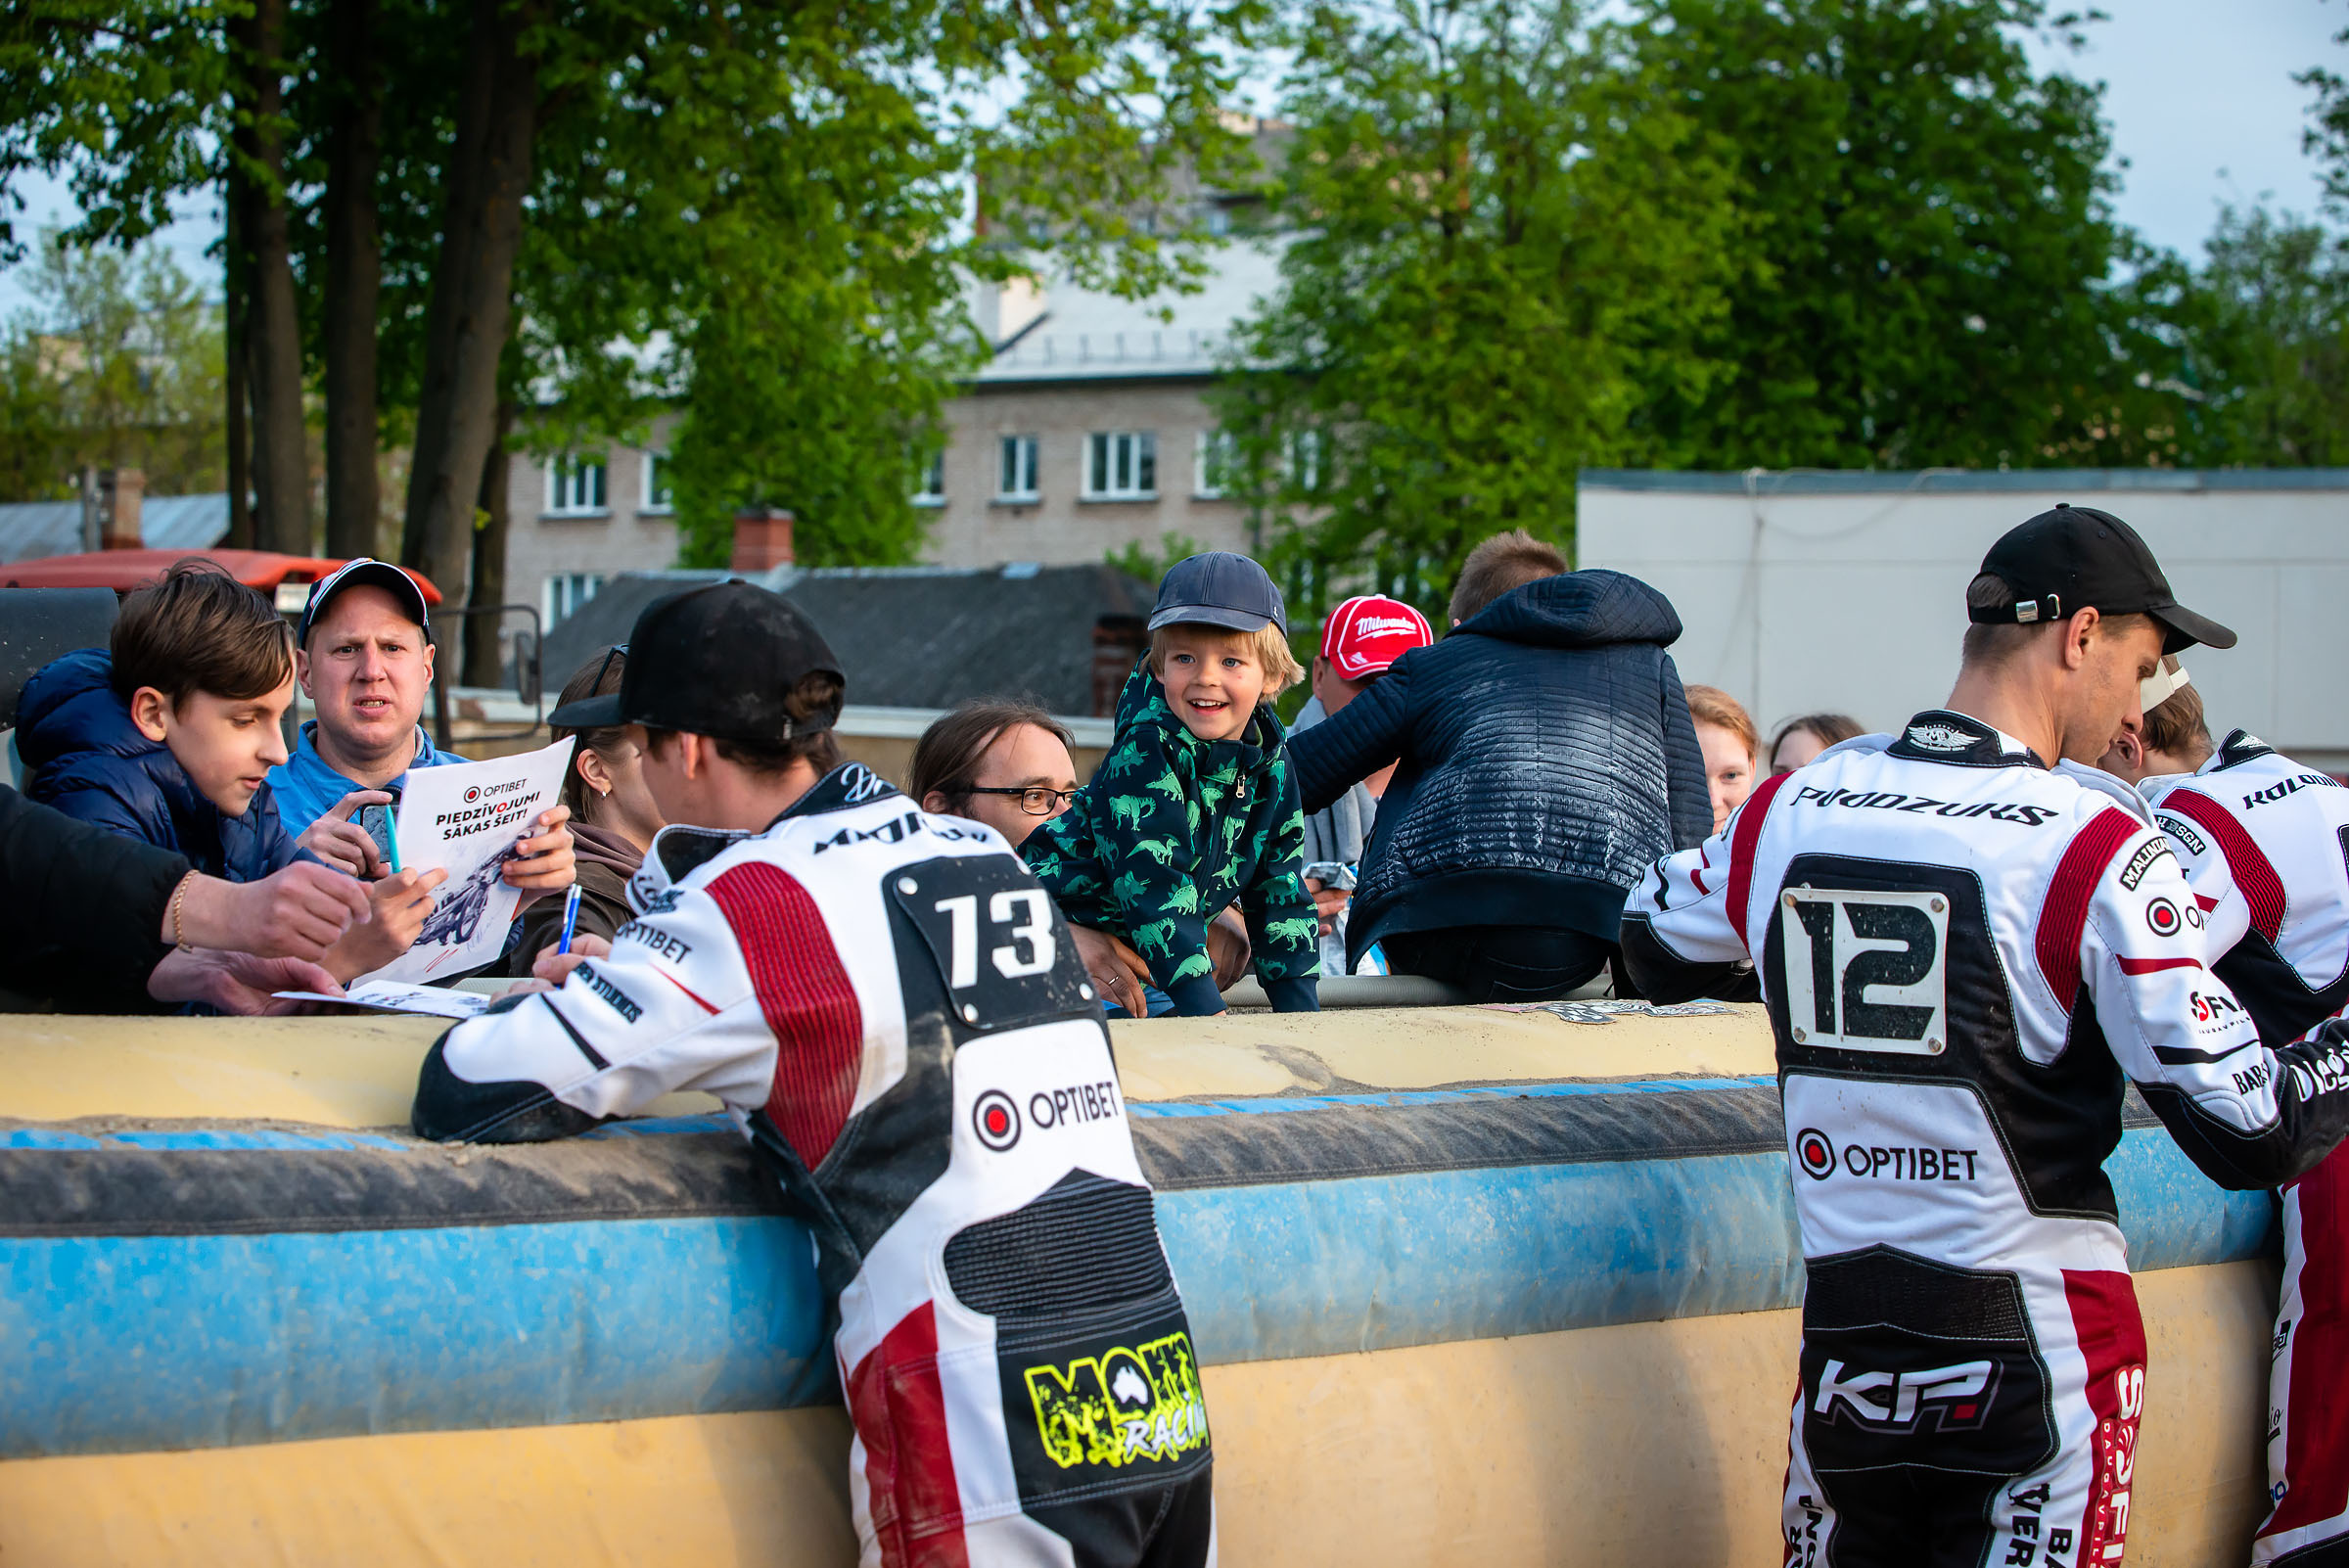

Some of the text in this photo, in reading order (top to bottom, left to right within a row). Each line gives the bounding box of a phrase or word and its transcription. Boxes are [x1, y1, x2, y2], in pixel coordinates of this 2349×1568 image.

[484, 778, 528, 798] OPTIBET
[436, 791, 540, 826] PIEDZĪVOJUMI
[442, 808, 528, 840] SĀKAS ŠEIT!
[935, 888, 1056, 991] 13
[1794, 900, 1937, 1040] 12
[1031, 1082, 1119, 1130] OPTIBET
[1844, 1143, 1978, 1180] OPTIBET
